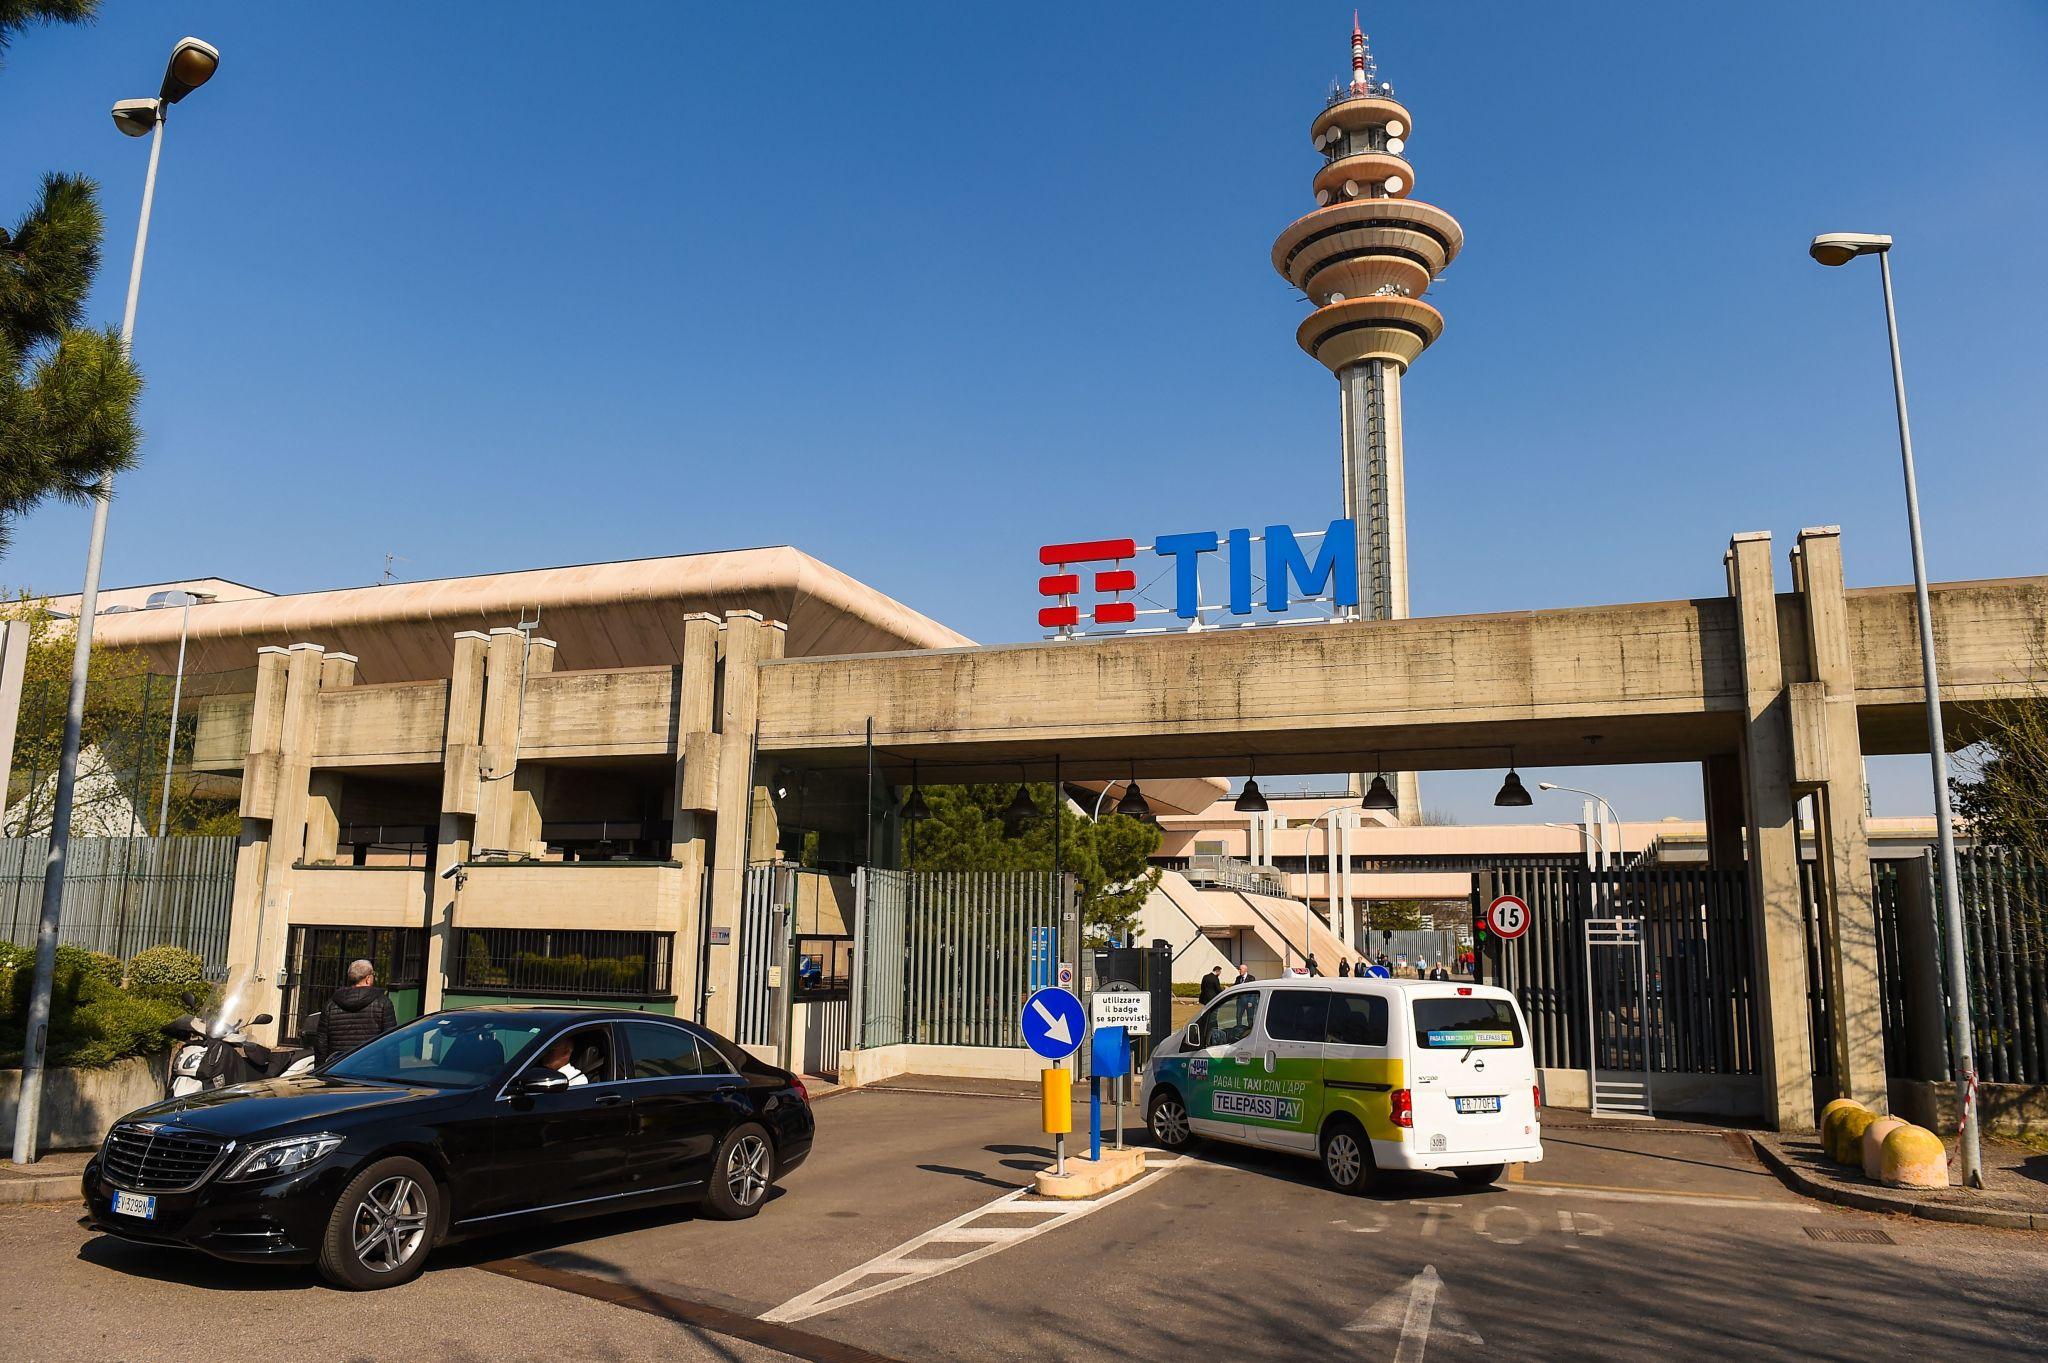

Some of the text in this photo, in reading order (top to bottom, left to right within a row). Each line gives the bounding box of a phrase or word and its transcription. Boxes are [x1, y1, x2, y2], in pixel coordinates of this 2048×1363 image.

[1156, 519, 1357, 618] TIM
[1499, 907, 1519, 927] 15
[1102, 996, 1141, 1004] utilizzare
[1105, 1005, 1138, 1015] il badge
[1107, 1014, 1147, 1024] sprovvisti
[1213, 1075, 1233, 1087] PAGA
[1234, 1078, 1241, 1089] IL
[1243, 1077, 1262, 1091] TAXI
[1263, 1080, 1280, 1093] CON
[1216, 1095, 1300, 1118] TELEPASS PAY
